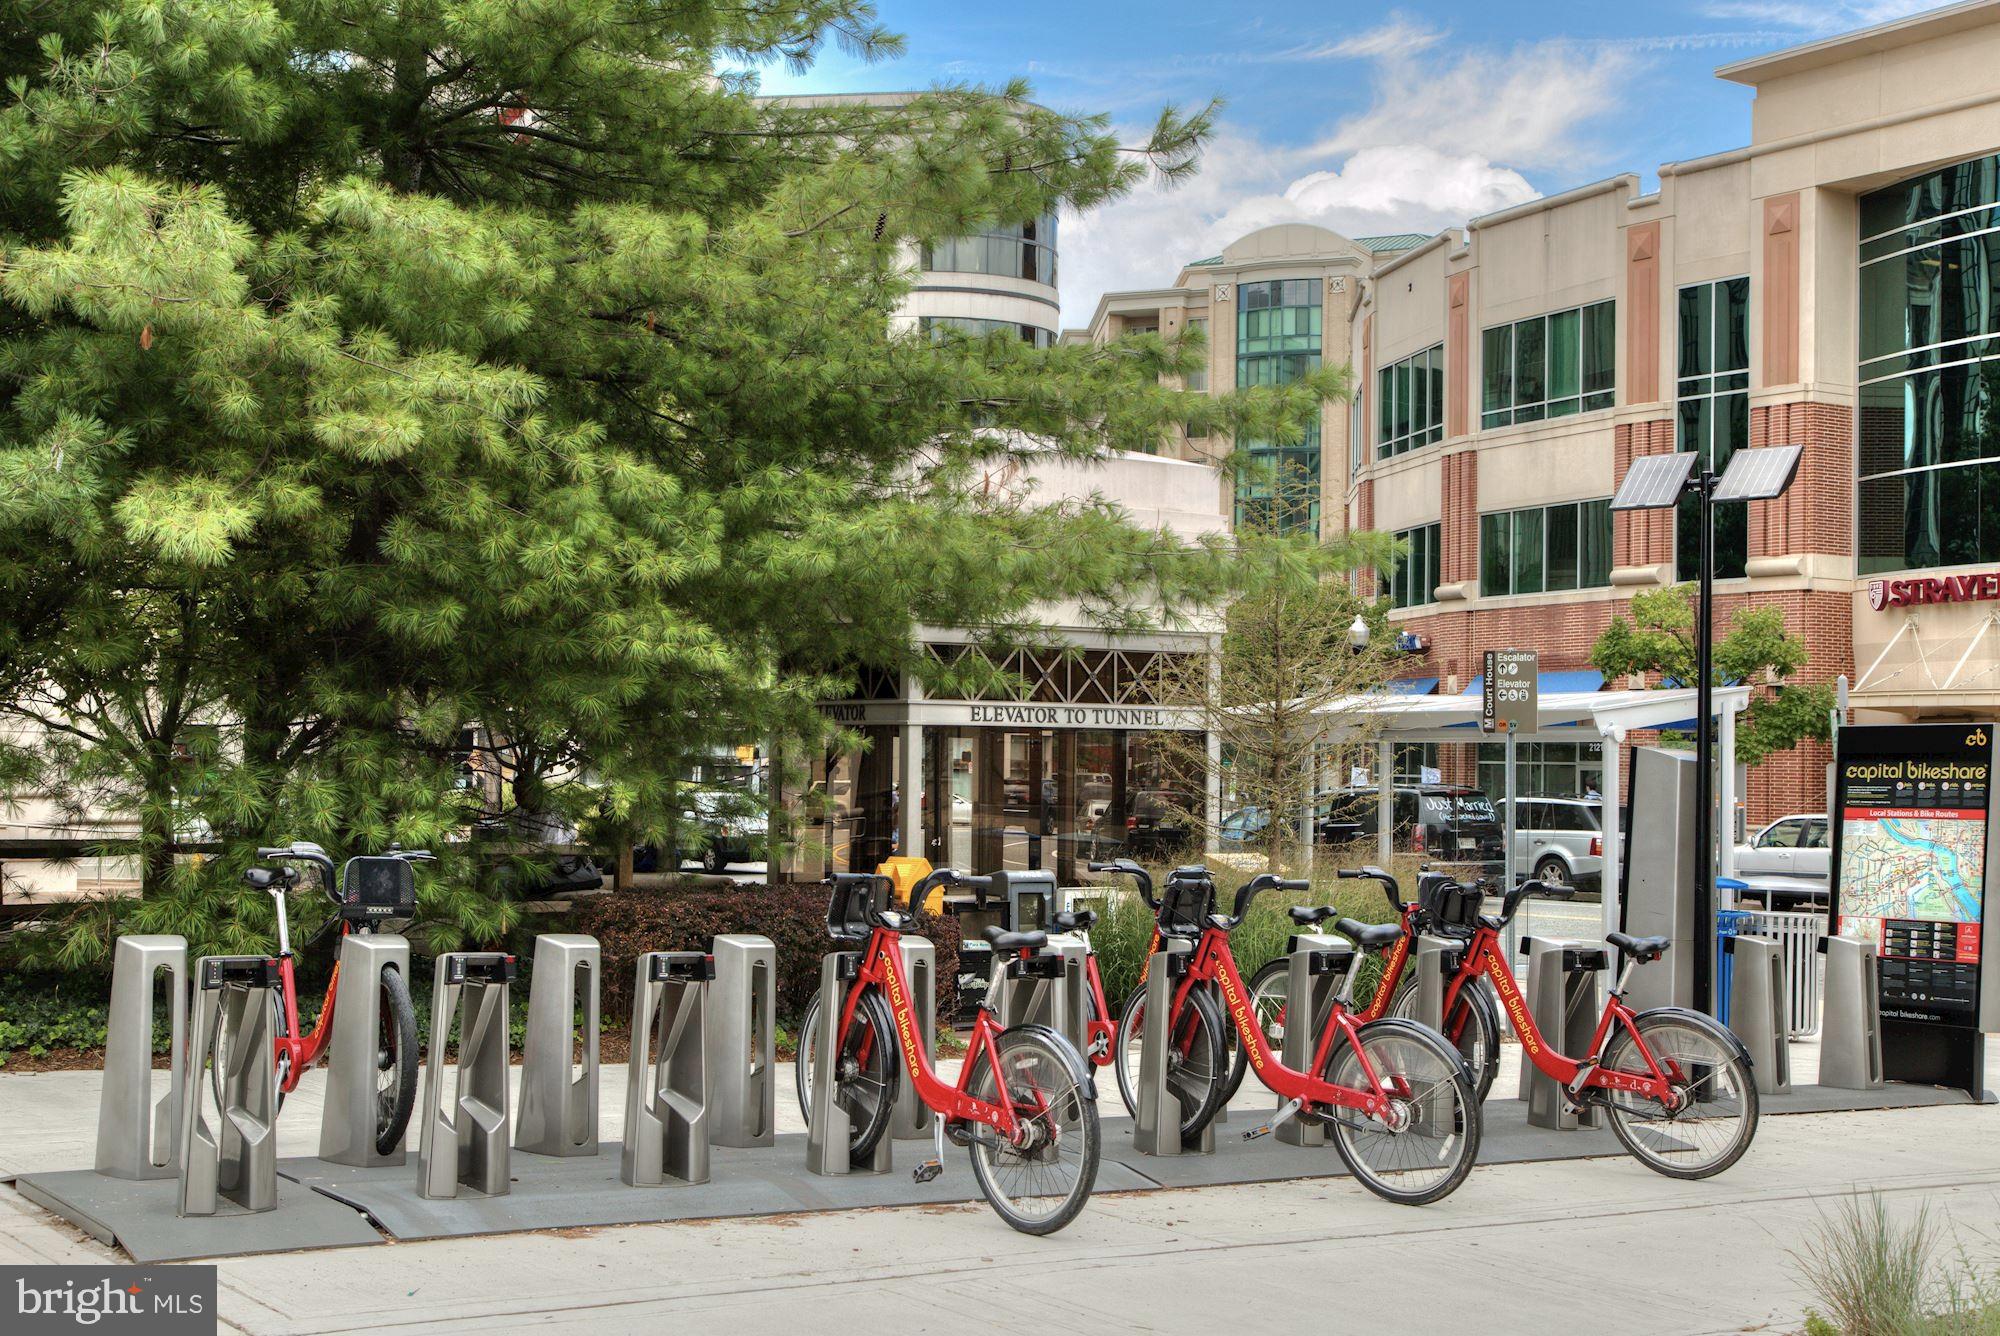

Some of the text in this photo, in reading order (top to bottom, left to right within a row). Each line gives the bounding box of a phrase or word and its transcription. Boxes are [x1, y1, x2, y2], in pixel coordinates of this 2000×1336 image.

[1889, 573, 2000, 607] STRAYE
[1485, 653, 1493, 685] House
[1498, 653, 1535, 661] Escalator
[1498, 680, 1530, 688] Elevator
[970, 706, 1164, 726] ELEVATOR TO TUNNEL
[1485, 688, 1493, 716] Court
[1846, 760, 1986, 782] capital bikeshare
[1426, 797, 1494, 812] Just Married
[1383, 936, 1406, 981] bikeshare
[884, 956, 919, 1077] capital bikeshare
[1488, 954, 1539, 1054] capital bikeshare
[1235, 1006, 1264, 1069] bikeshare
